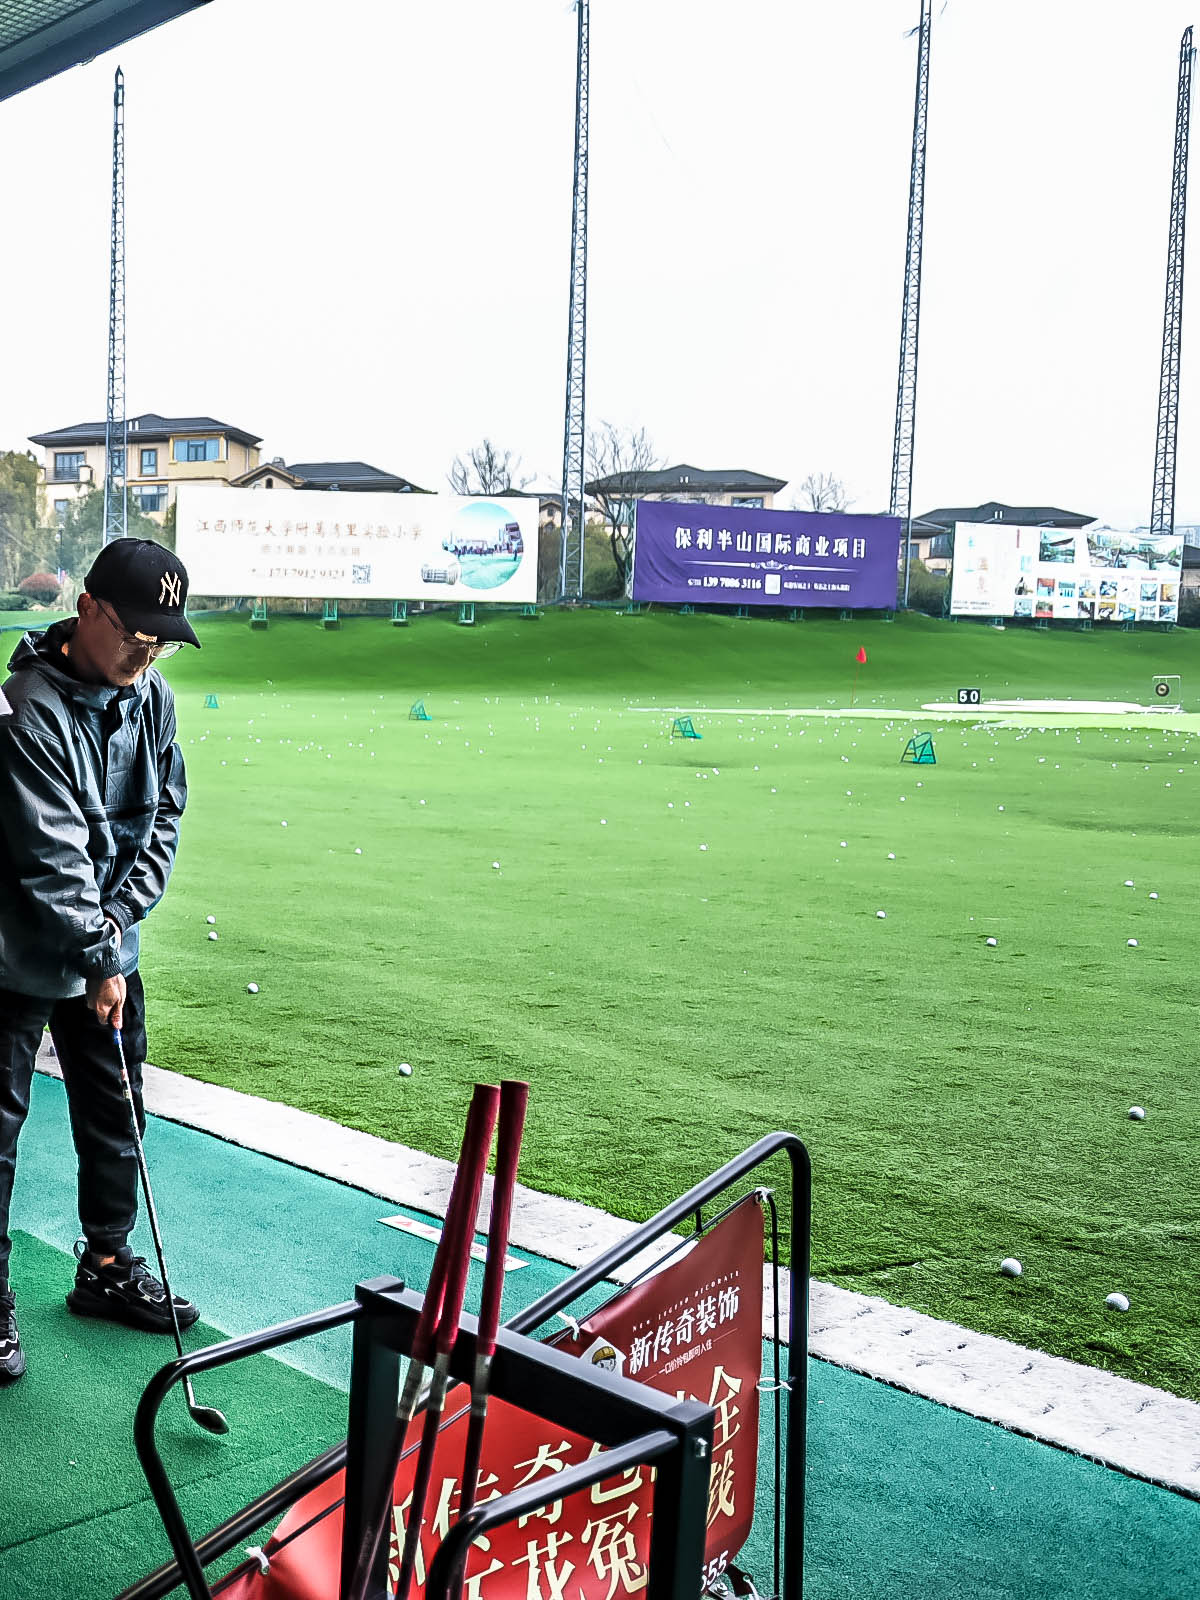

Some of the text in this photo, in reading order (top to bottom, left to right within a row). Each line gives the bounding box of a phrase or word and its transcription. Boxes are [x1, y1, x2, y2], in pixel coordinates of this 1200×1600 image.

[675, 526, 867, 560] 保利半山国际商业项目
[959, 690, 979, 702] 50
[658, 1297, 690, 1320] LEGEND
[694, 1270, 740, 1298] DECORATE
[629, 1285, 742, 1376] 新传奇装饰
[658, 1338, 714, 1376] 一口价拎包即可入住
